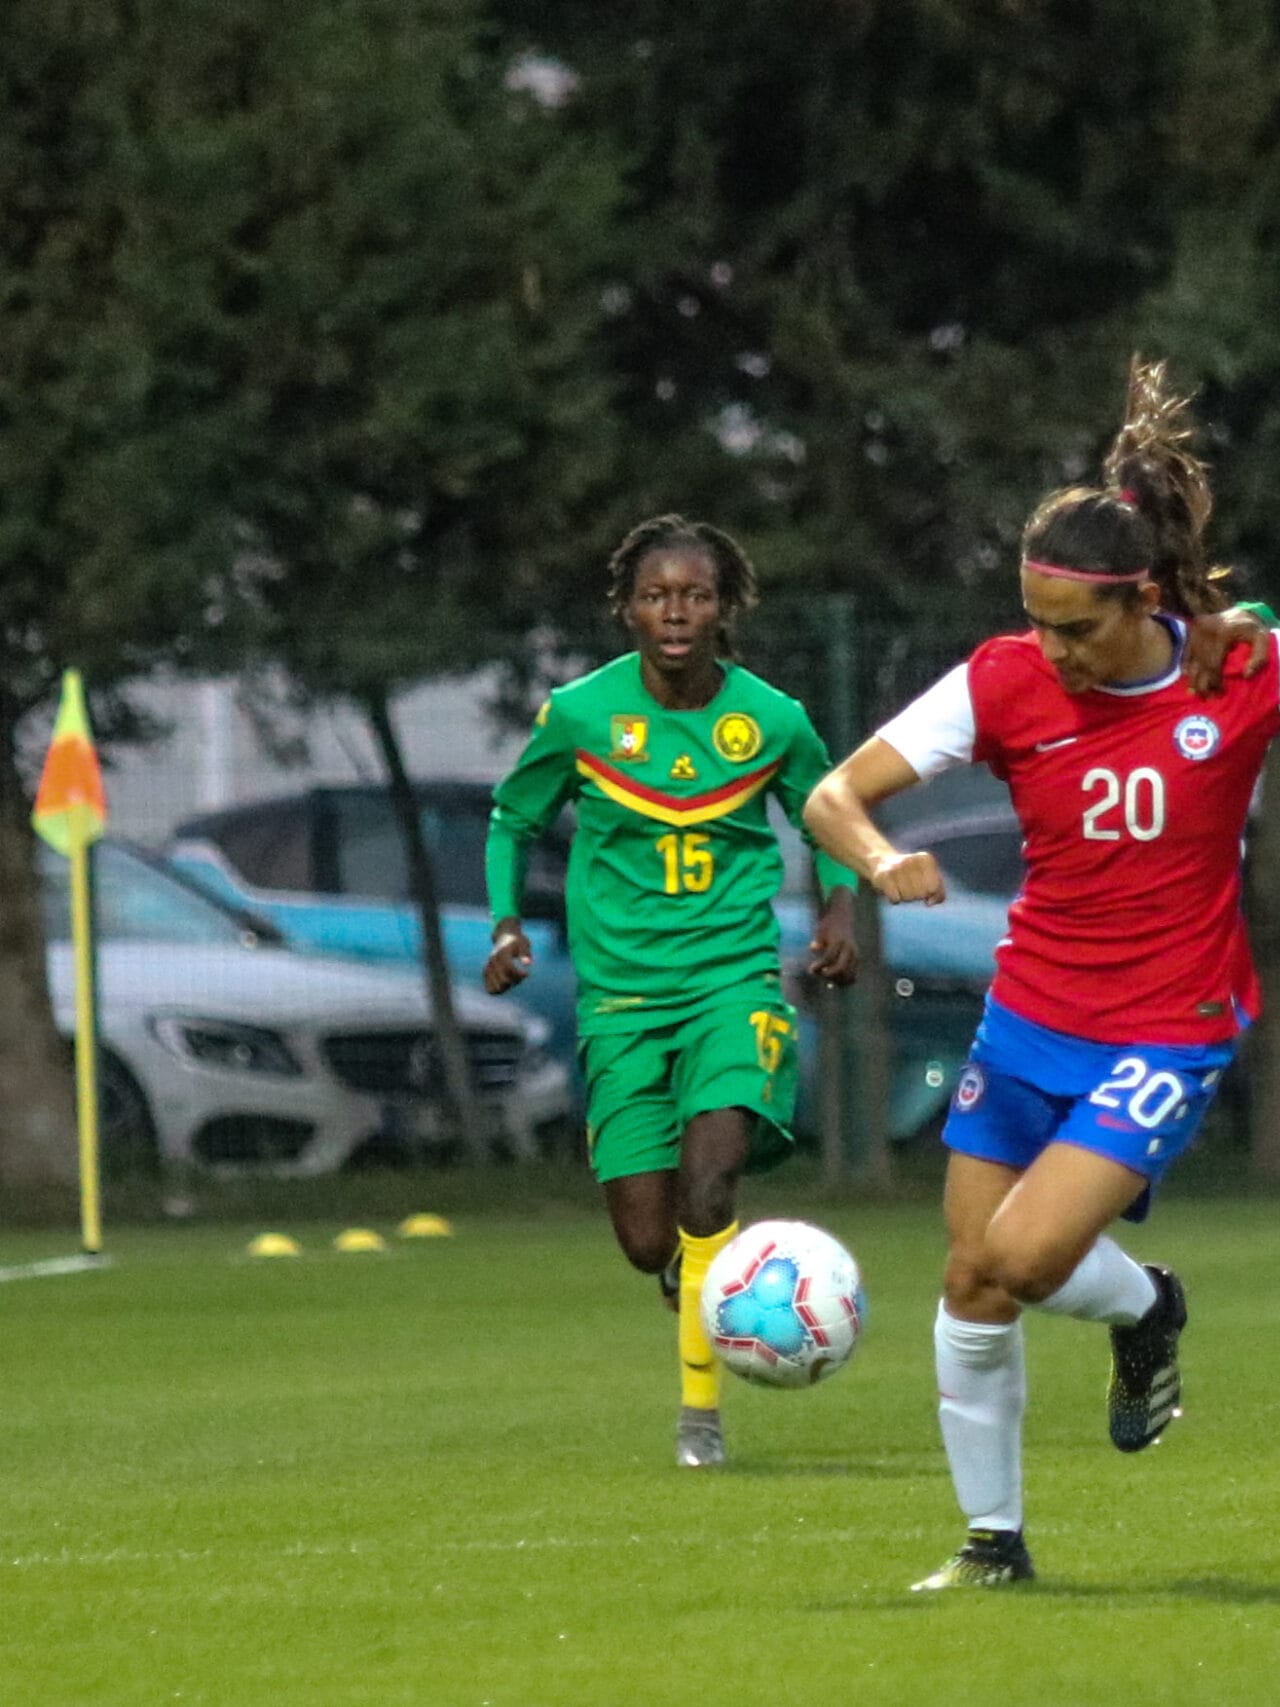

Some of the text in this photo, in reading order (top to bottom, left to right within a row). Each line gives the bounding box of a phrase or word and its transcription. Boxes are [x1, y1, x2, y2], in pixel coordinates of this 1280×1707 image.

[1081, 767, 1164, 841] 20
[655, 833, 713, 893] 15
[749, 1011, 789, 1072] 15
[1089, 1057, 1182, 1128] 20
